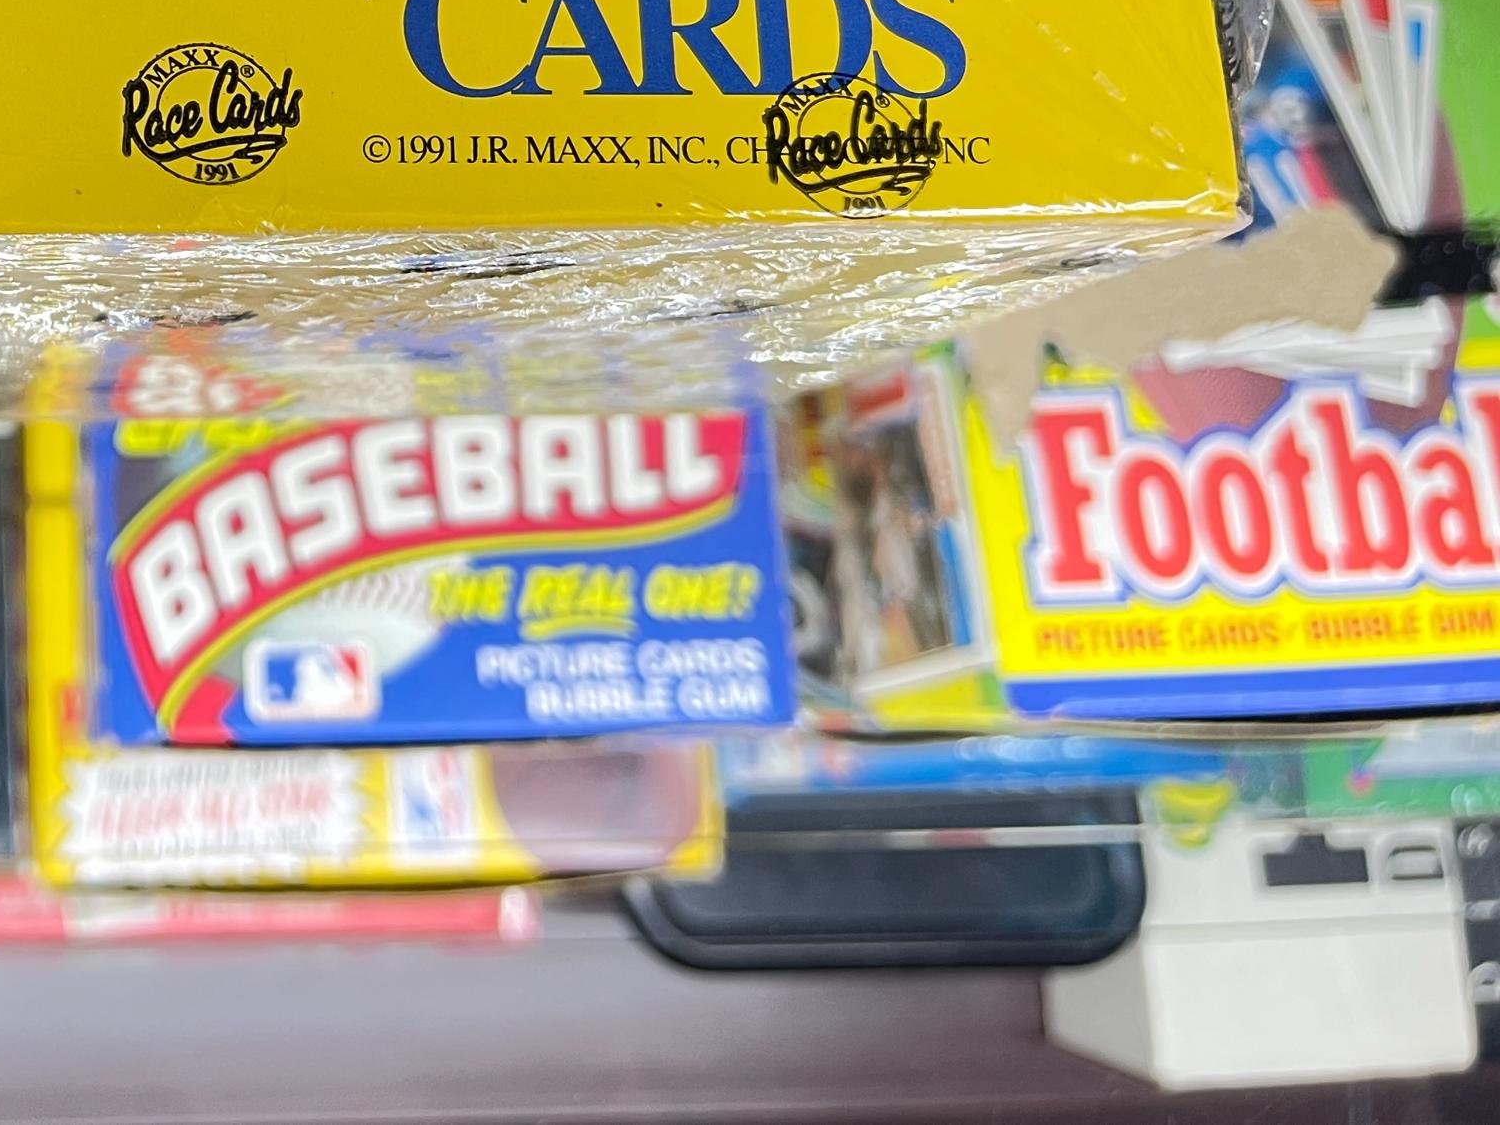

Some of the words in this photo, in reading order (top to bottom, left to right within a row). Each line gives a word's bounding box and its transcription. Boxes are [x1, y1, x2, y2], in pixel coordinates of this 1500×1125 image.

[145, 47, 222, 90] MAXX
[121, 77, 205, 158] Race
[209, 58, 304, 135] Cards
[780, 77, 855, 118] MAXX
[850, 89, 944, 165] Cards
[192, 161, 242, 183] 1991
[467, 136, 518, 165] J.R.
[524, 136, 641, 169] MAXX,
[648, 136, 720, 169] INC.,
[942, 136, 992, 165] NC
[126, 413, 722, 665] BASEBALL
[1033, 617, 1171, 663] PICTURE
[1178, 611, 1280, 655] CARDS
